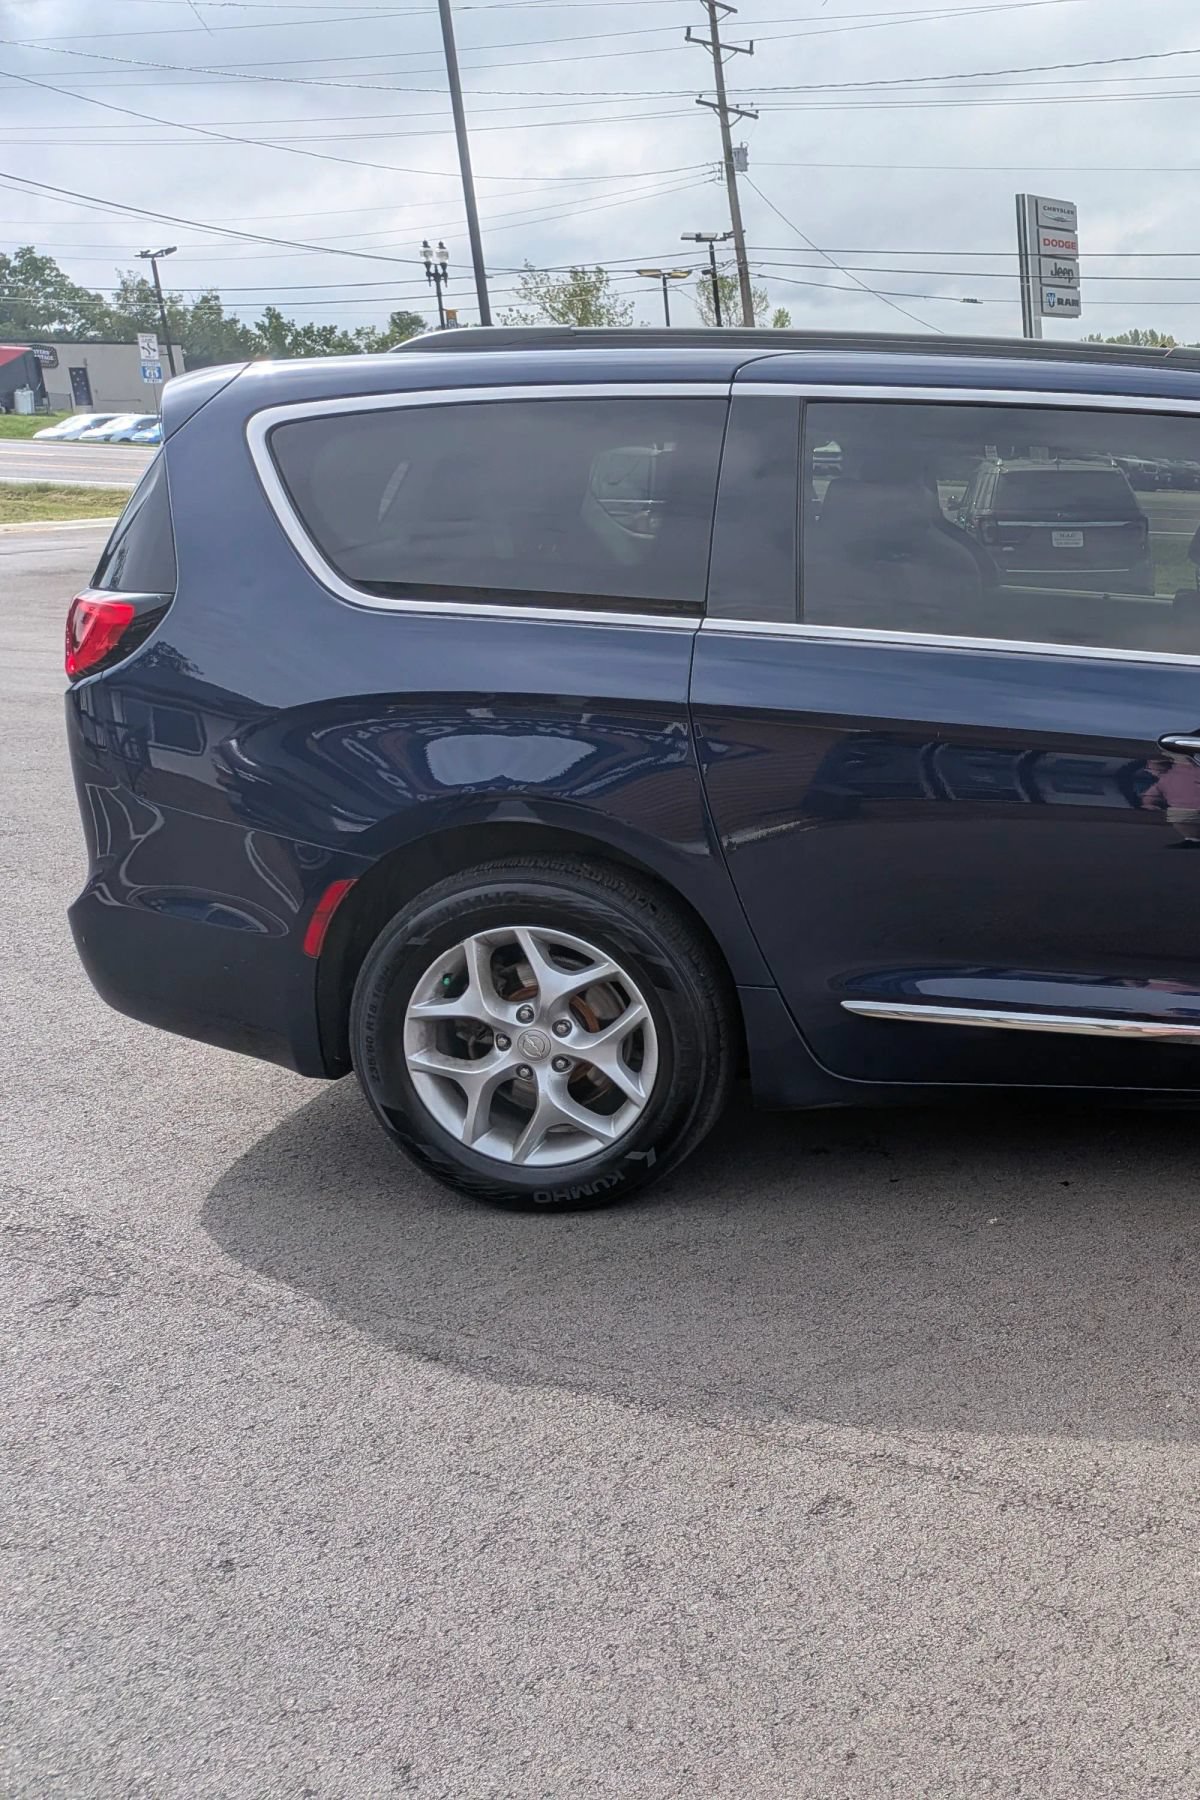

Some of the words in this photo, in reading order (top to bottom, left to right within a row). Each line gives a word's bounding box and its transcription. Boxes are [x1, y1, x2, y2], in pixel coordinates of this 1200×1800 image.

[1043, 205, 1075, 216] CHRYSLER
[1043, 238, 1077, 250] DODGE
[1050, 262, 1075, 284] Jeep
[1057, 296, 1080, 308] RAM
[532, 1168, 626, 1204] KUMHO
